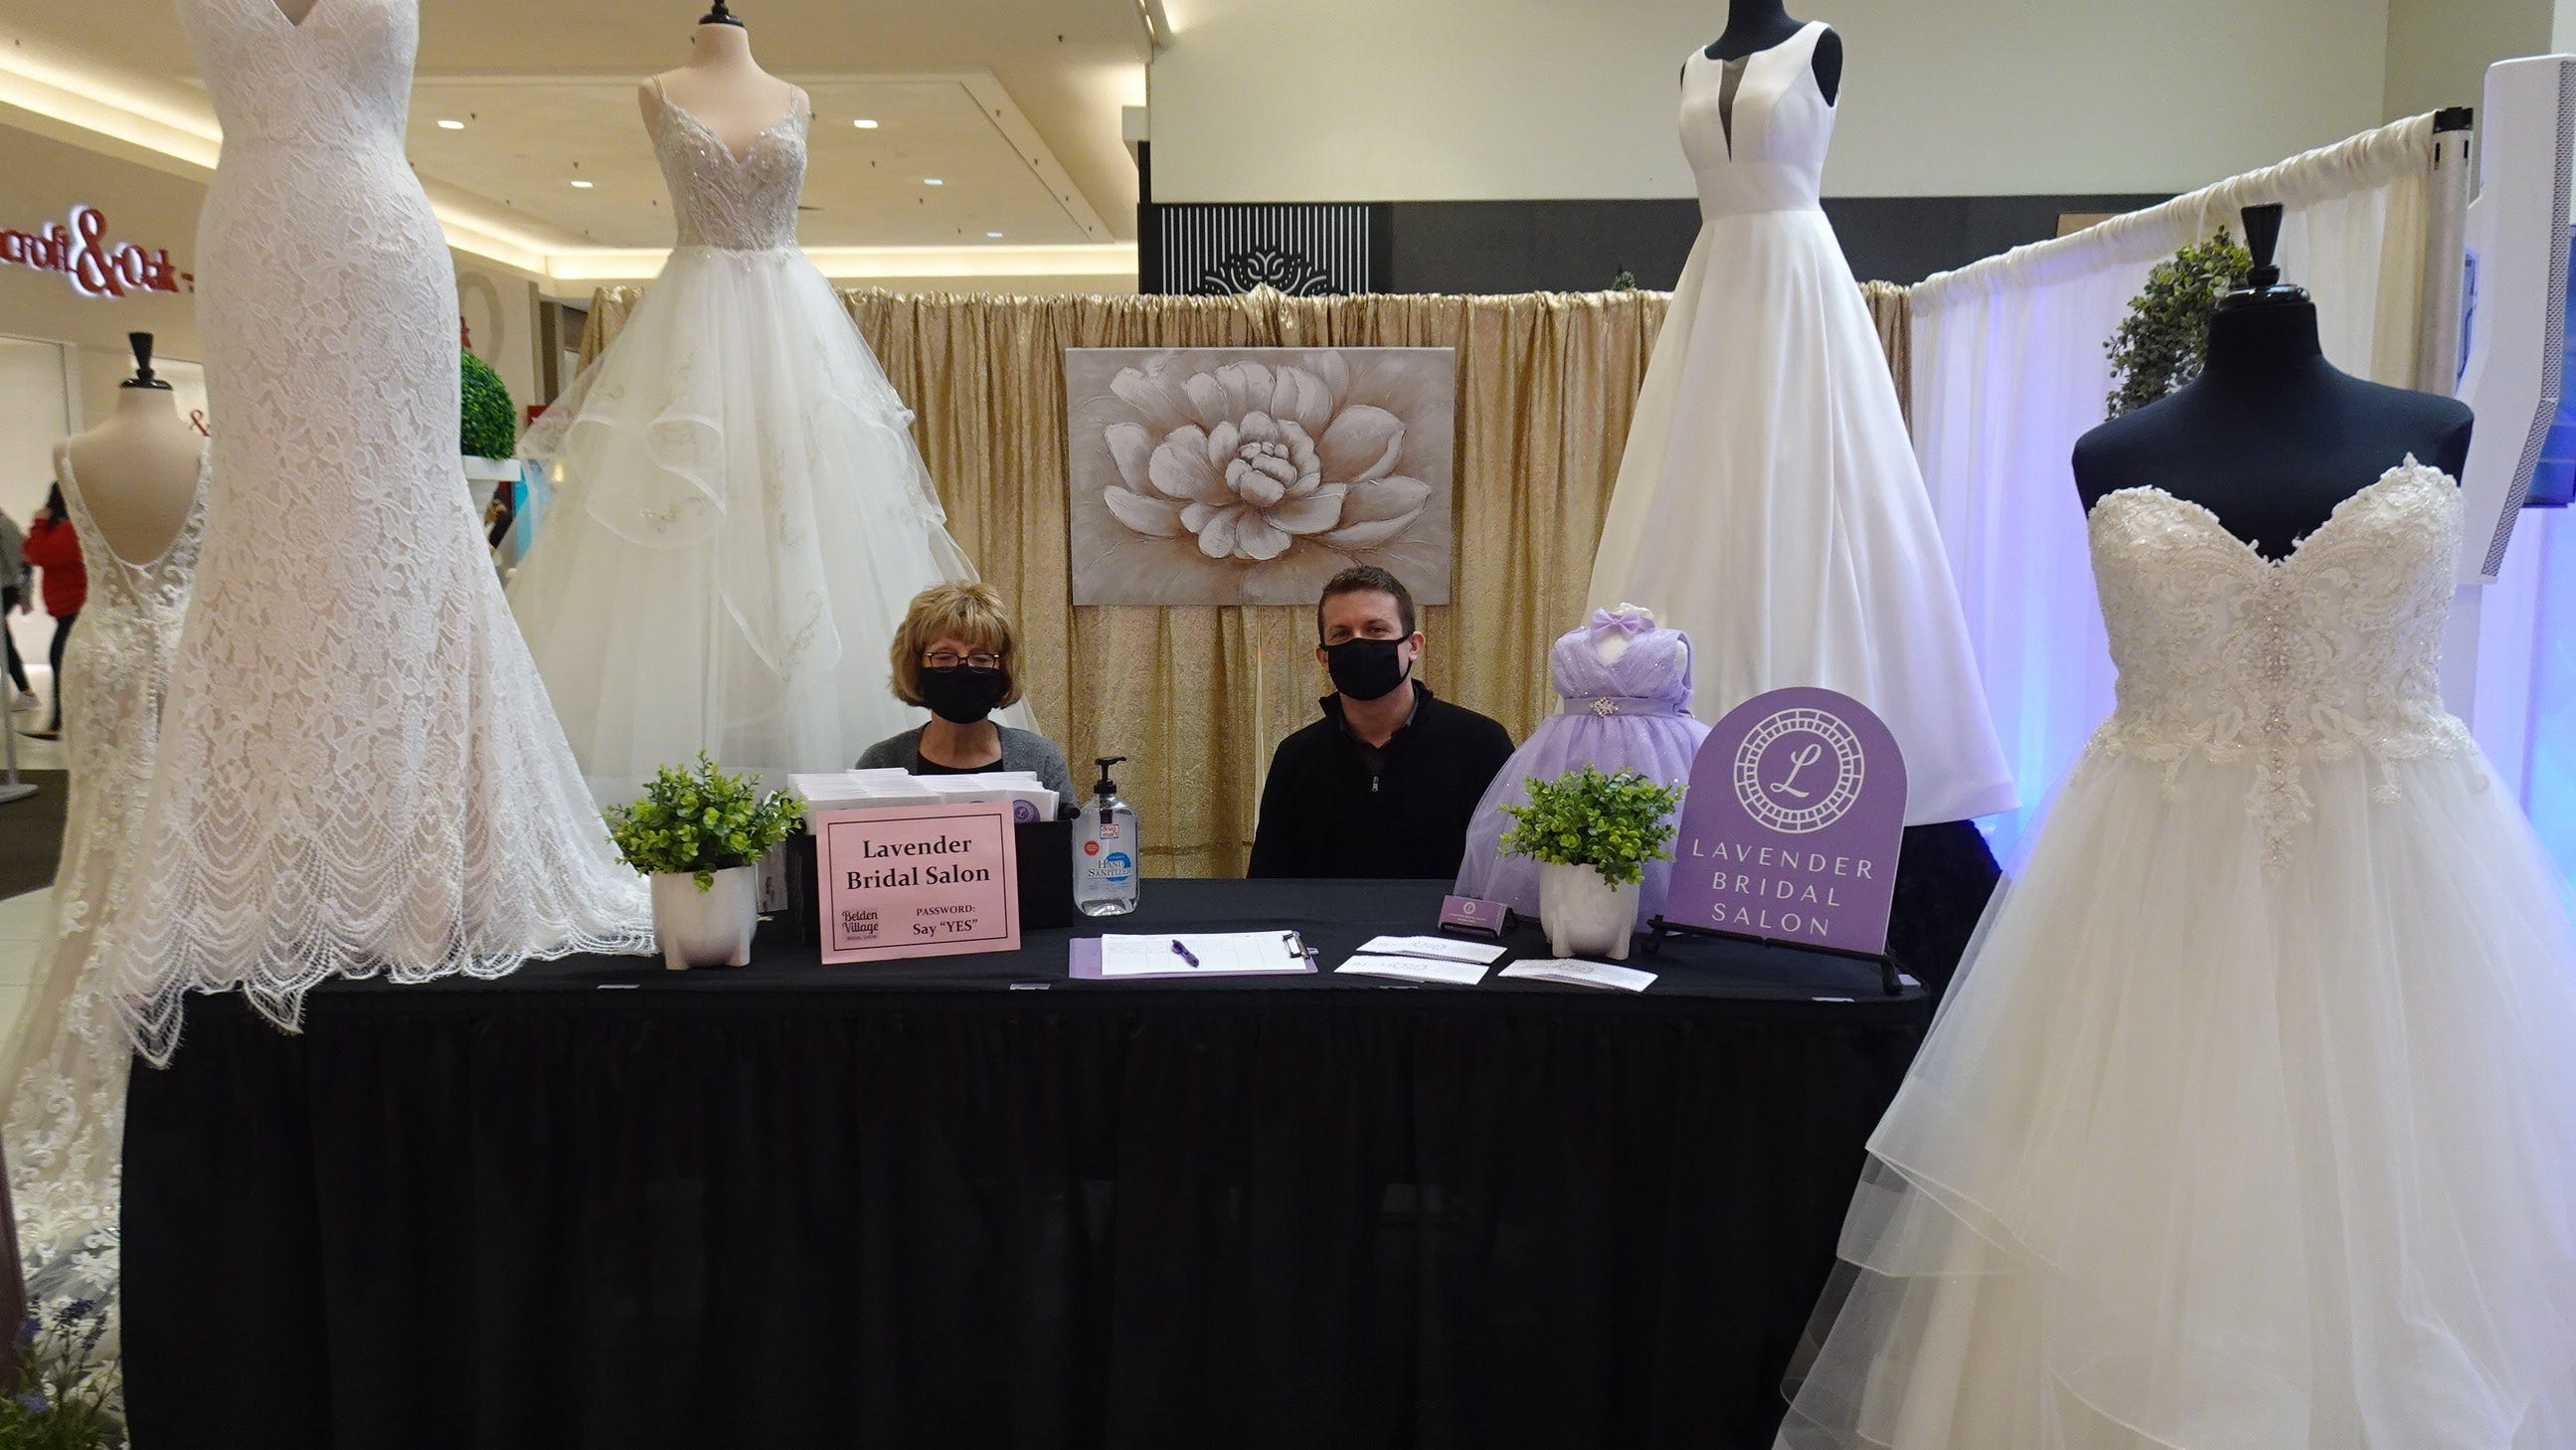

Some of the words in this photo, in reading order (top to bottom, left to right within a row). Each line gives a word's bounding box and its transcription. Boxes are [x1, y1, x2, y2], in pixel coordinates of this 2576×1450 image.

[1770, 743, 1822, 799] L
[862, 834, 972, 859] Lavender
[1692, 838, 1873, 879] LAVENDER
[846, 866, 919, 890] Bridal
[926, 864, 991, 885] Salon
[1712, 871, 1840, 907] BRIDAL
[841, 910, 879, 922] Belden
[917, 904, 976, 916] PASSWORD:
[1711, 902, 1828, 937] SALON
[841, 922, 880, 935] Village
[913, 923, 937, 937] Say
